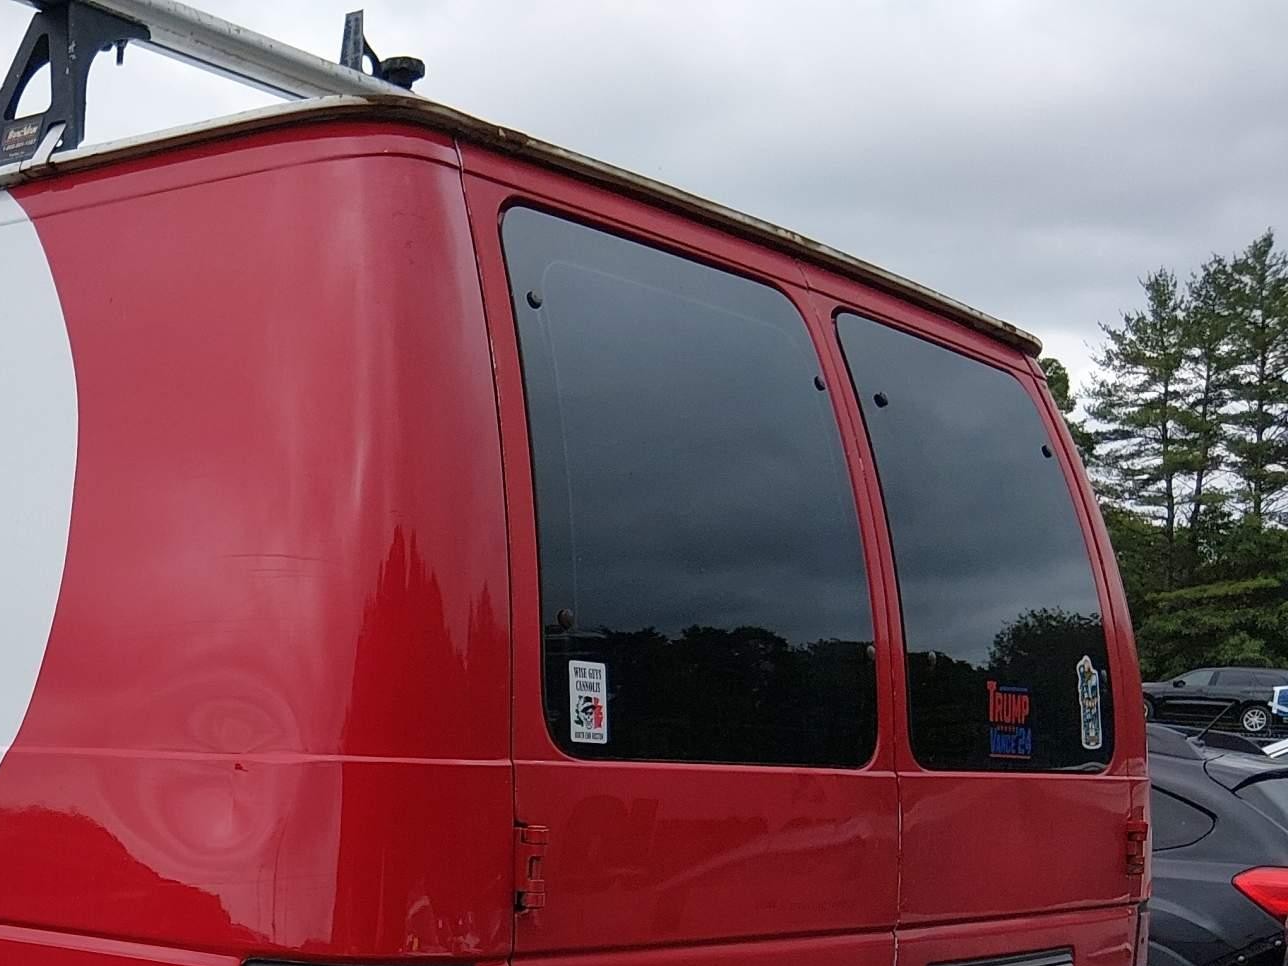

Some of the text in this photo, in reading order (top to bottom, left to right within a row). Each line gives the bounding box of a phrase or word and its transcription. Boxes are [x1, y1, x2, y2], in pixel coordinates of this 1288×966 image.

[574, 666, 602, 680] WISE GUYS
[987, 681, 1030, 724] TRUMP
